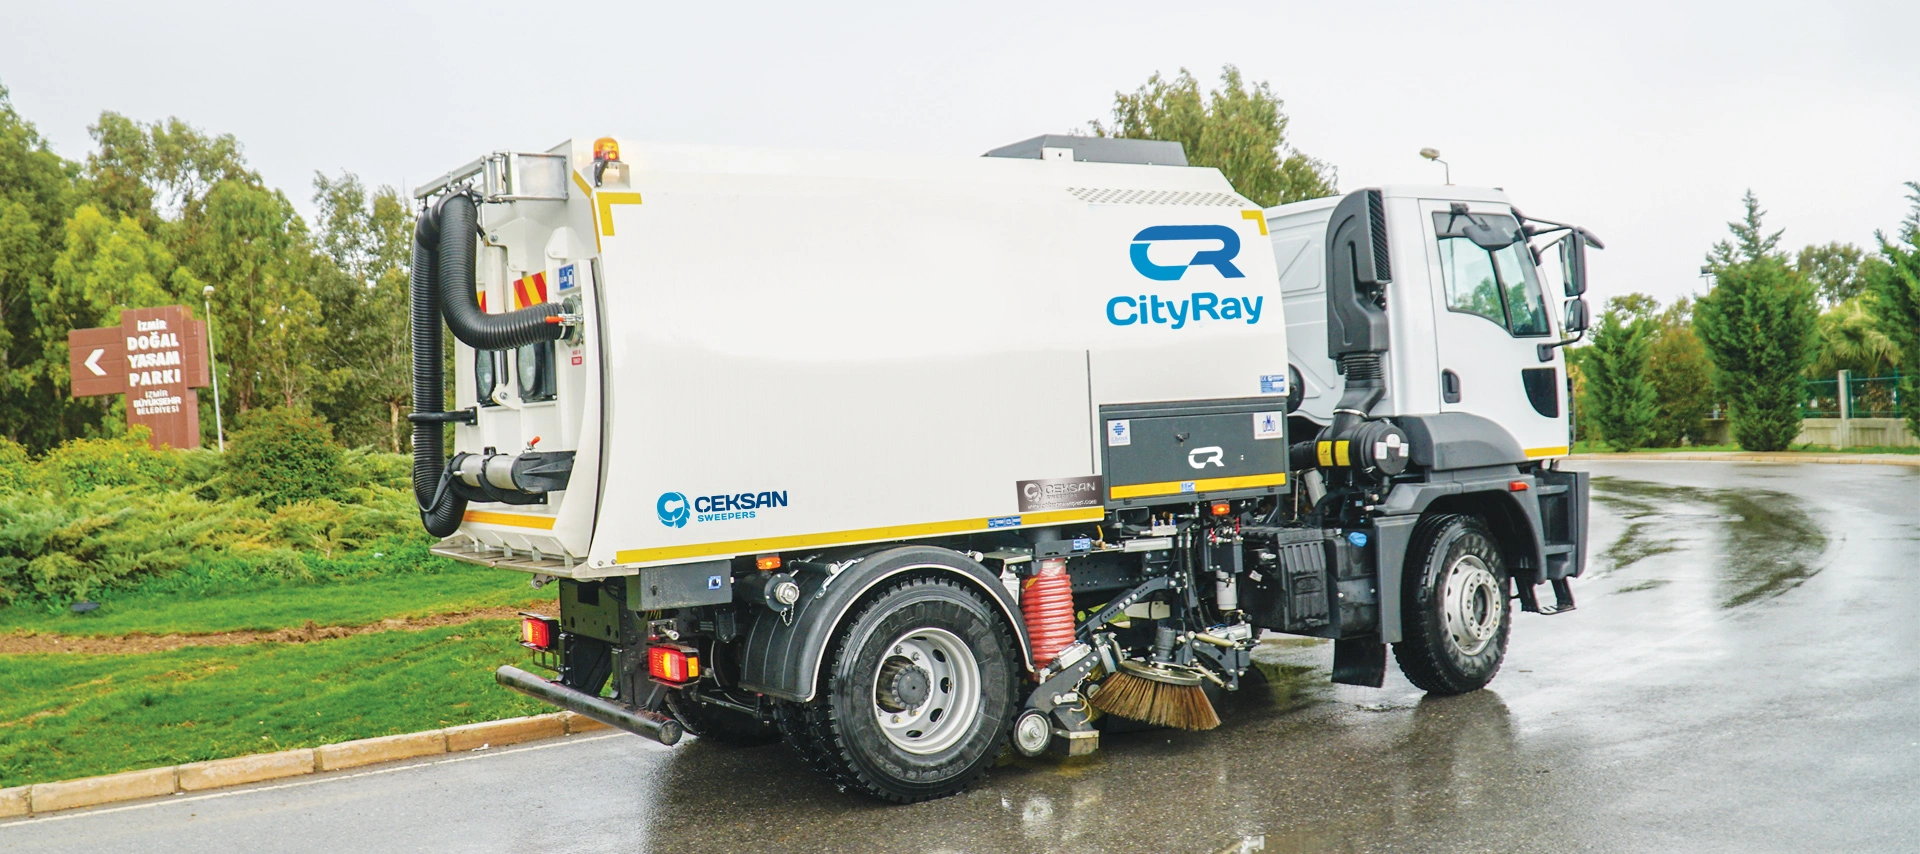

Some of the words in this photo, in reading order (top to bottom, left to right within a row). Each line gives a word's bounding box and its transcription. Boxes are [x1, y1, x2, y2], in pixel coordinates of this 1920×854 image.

[1106, 292, 1263, 329] CityRay
[126, 331, 180, 350] DOĞAL
[129, 368, 181, 387] PARKI
[694, 490, 788, 513] CEKSAN
[697, 511, 756, 522] SWEEPERS
